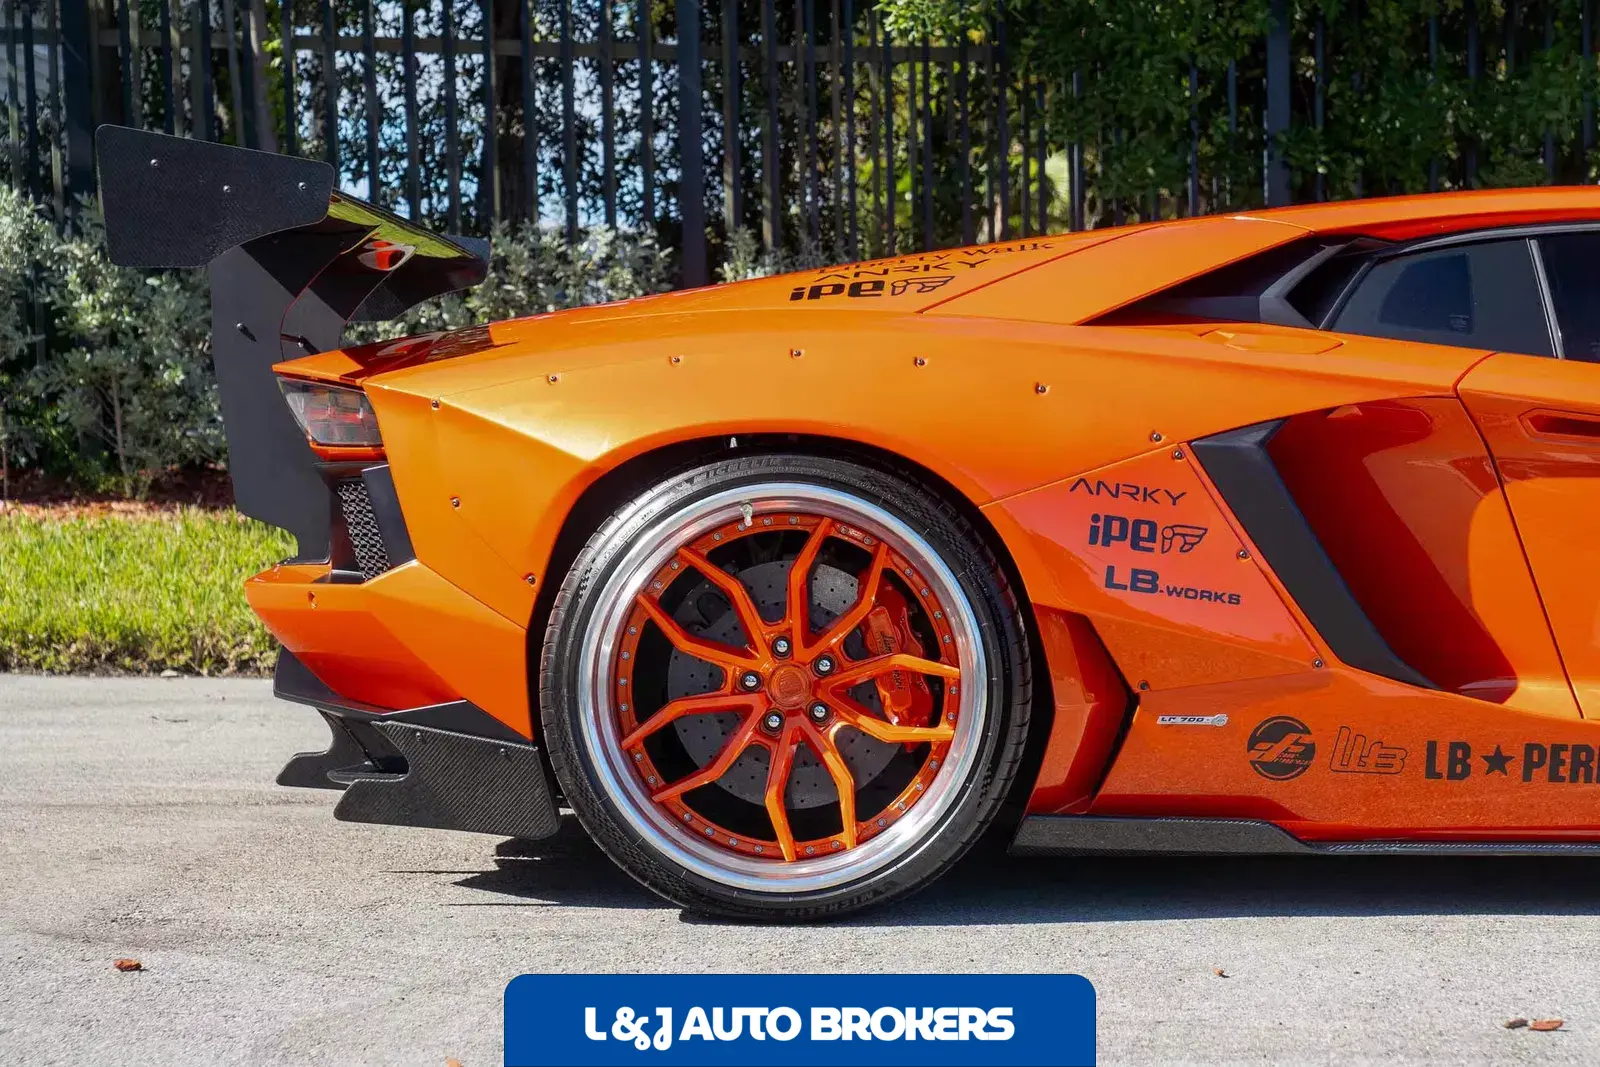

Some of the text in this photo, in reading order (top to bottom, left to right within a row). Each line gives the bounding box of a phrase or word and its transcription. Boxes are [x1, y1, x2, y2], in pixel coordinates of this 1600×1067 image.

[814, 258, 990, 282] ANRKY
[1069, 477, 1187, 506] ANRKY
[1424, 740, 1600, 784] LB PER
